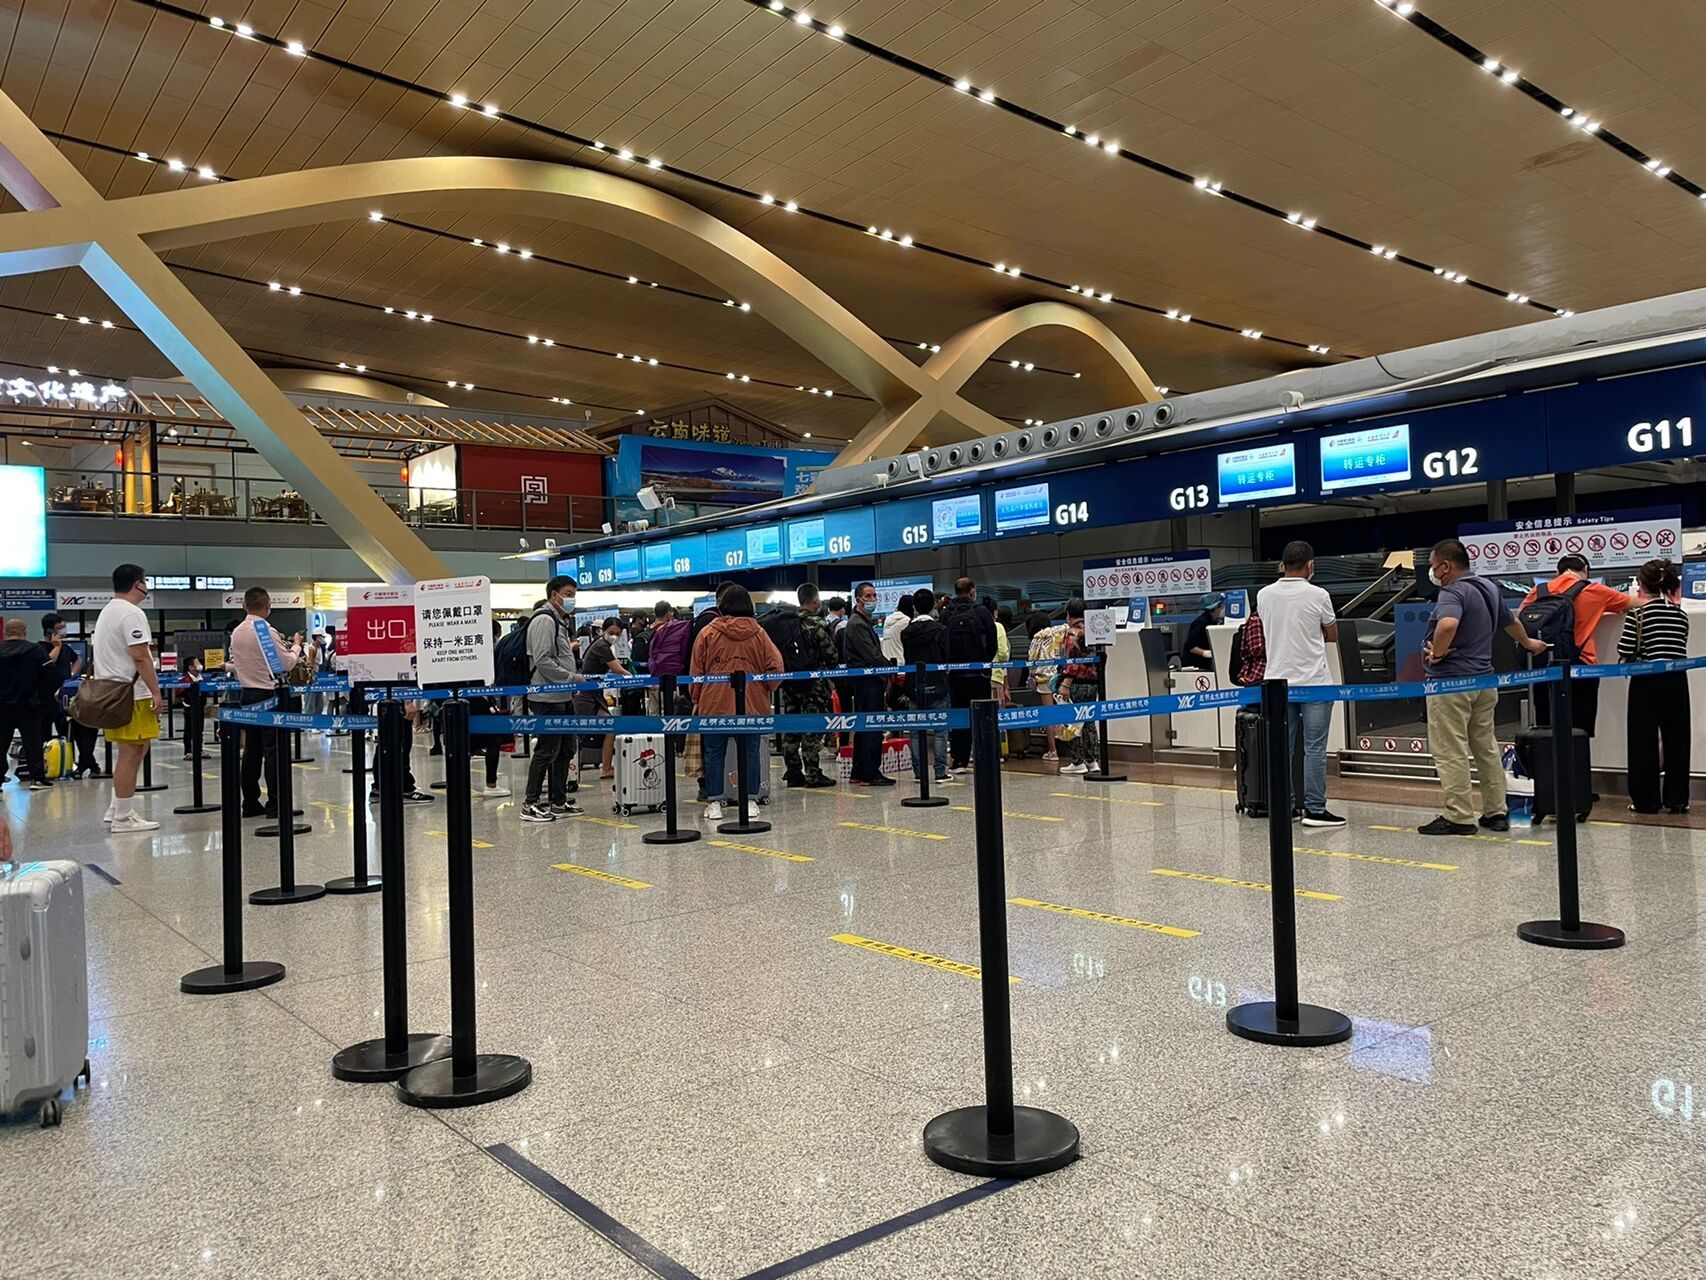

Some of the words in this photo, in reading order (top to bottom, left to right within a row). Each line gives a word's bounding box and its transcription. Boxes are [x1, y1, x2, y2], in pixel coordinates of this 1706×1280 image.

[0, 377, 127, 403] 文化遗产
[649, 418, 731, 444] 云南味道
[1627, 417, 1692, 453] G11
[1423, 447, 1478, 478] G12
[1170, 484, 1209, 511] G13
[1055, 501, 1089, 525] G14
[1515, 516, 1573, 530] 安全信息提示
[902, 525, 928, 544] G15
[829, 535, 850, 554] G16
[674, 557, 690, 573] G18
[725, 550, 744, 567] G17
[579, 571, 592, 585] G20
[598, 568, 612, 583] G19
[422, 605, 483, 621] 请您佩戴口罩
[367, 619, 406, 640] 出口
[423, 633, 484, 650] 保持一米距离
[660, 718, 692, 731] YAG
[824, 715, 857, 730] YAG
